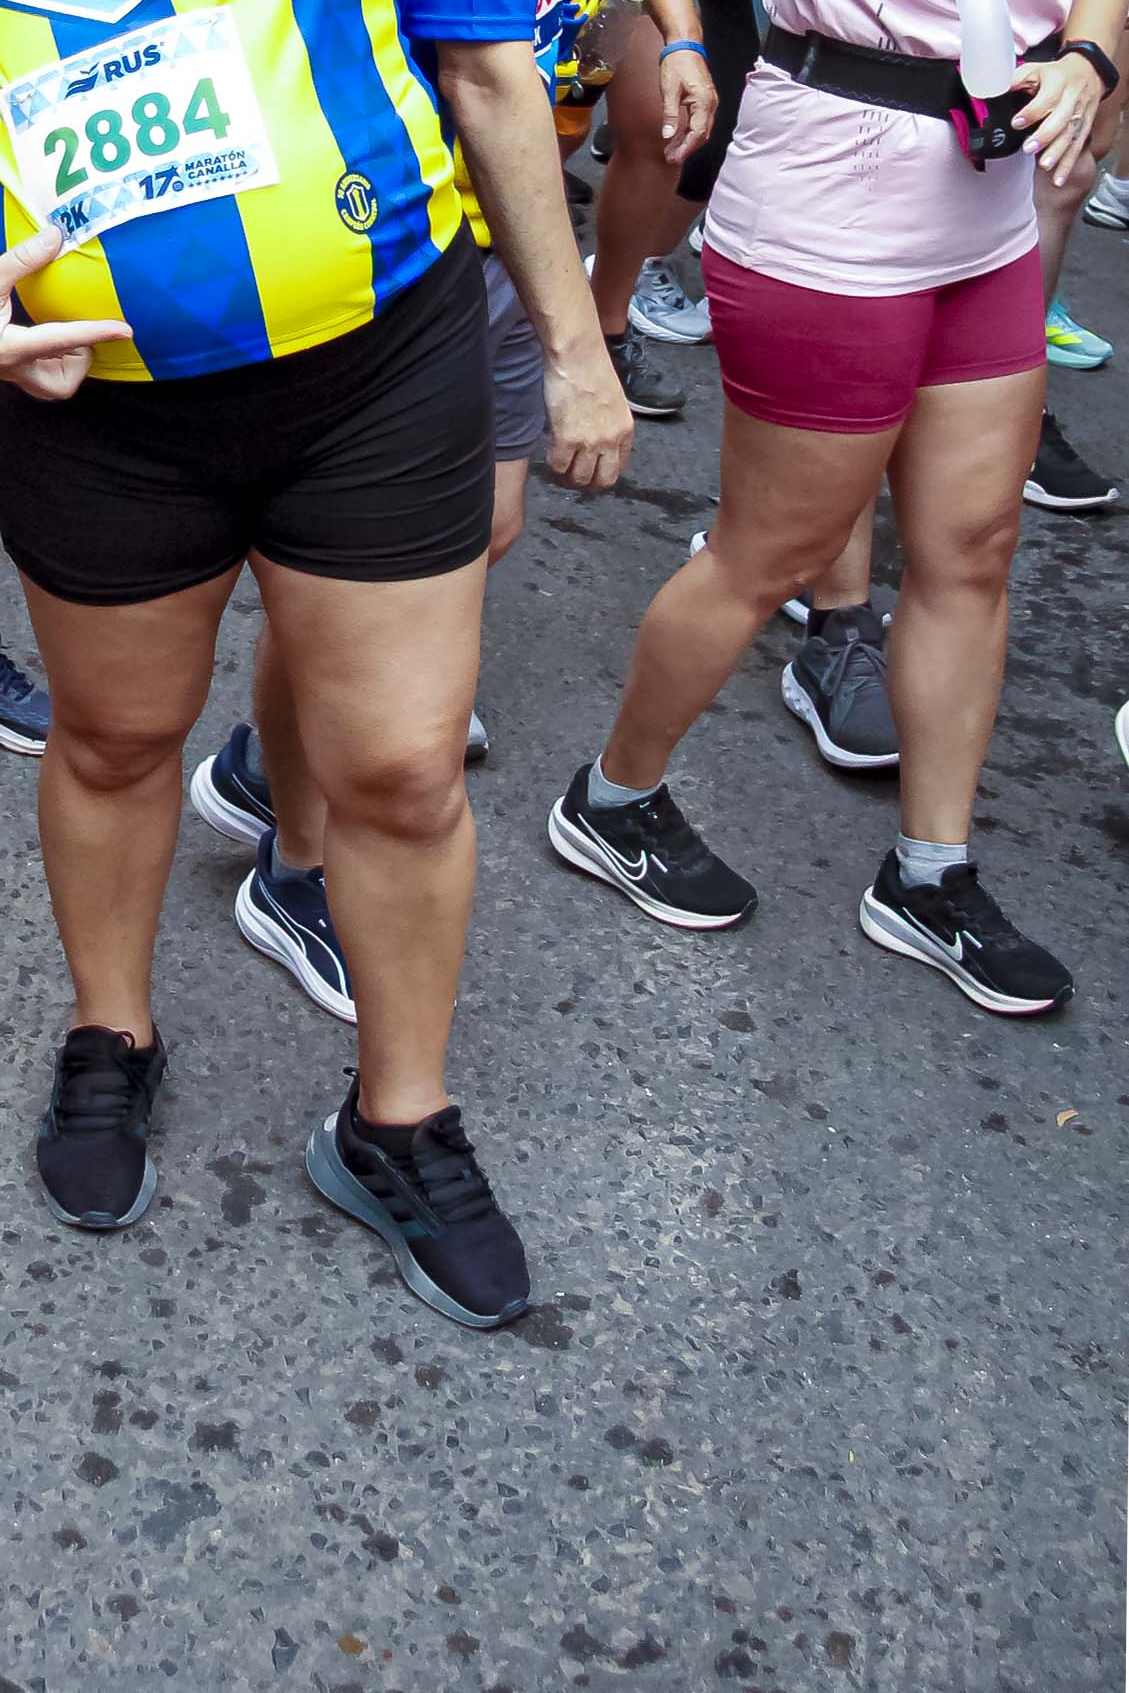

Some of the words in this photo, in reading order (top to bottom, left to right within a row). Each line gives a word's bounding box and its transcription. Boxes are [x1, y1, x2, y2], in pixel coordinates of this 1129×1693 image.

[103, 44, 162, 83] RUS
[43, 77, 231, 197] 2884
[184, 150, 246, 172] MARATÓN
[188, 160, 248, 180] CANALLA
[139, 164, 180, 200] 17
